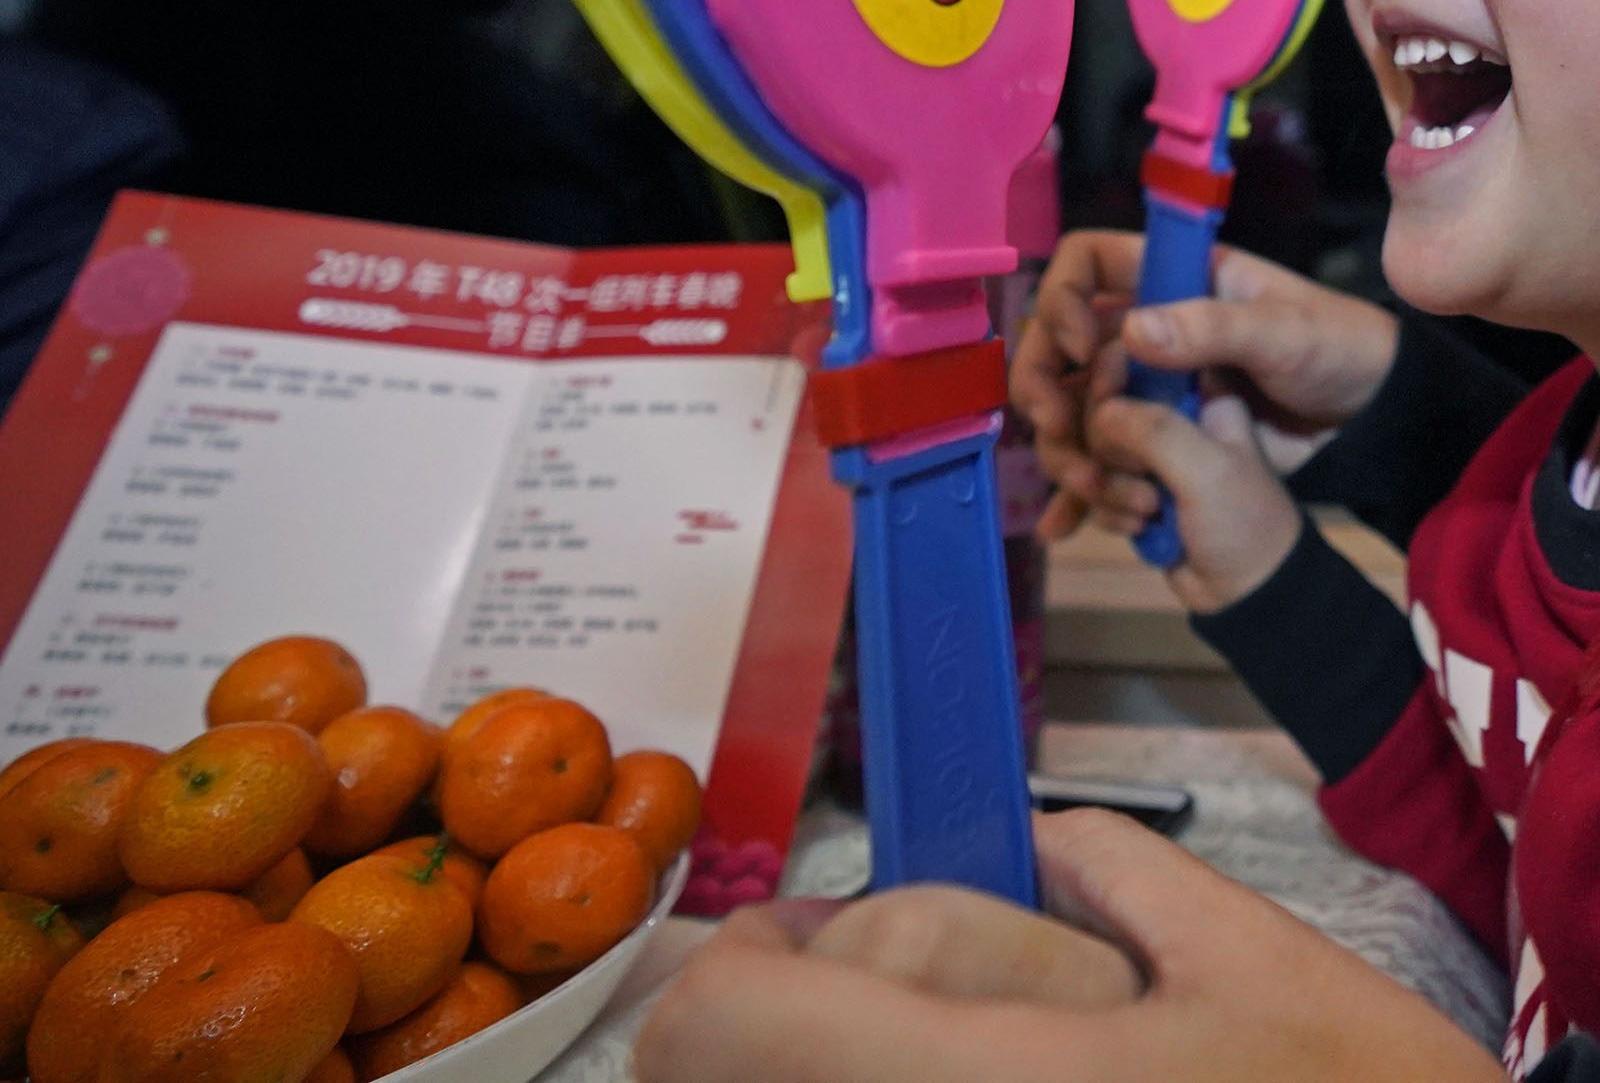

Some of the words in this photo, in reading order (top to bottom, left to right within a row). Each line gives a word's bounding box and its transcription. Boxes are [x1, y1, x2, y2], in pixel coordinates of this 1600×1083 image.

[306, 249, 406, 294] 2019
[407, 259, 450, 302] 年
[455, 265, 524, 308] T48
